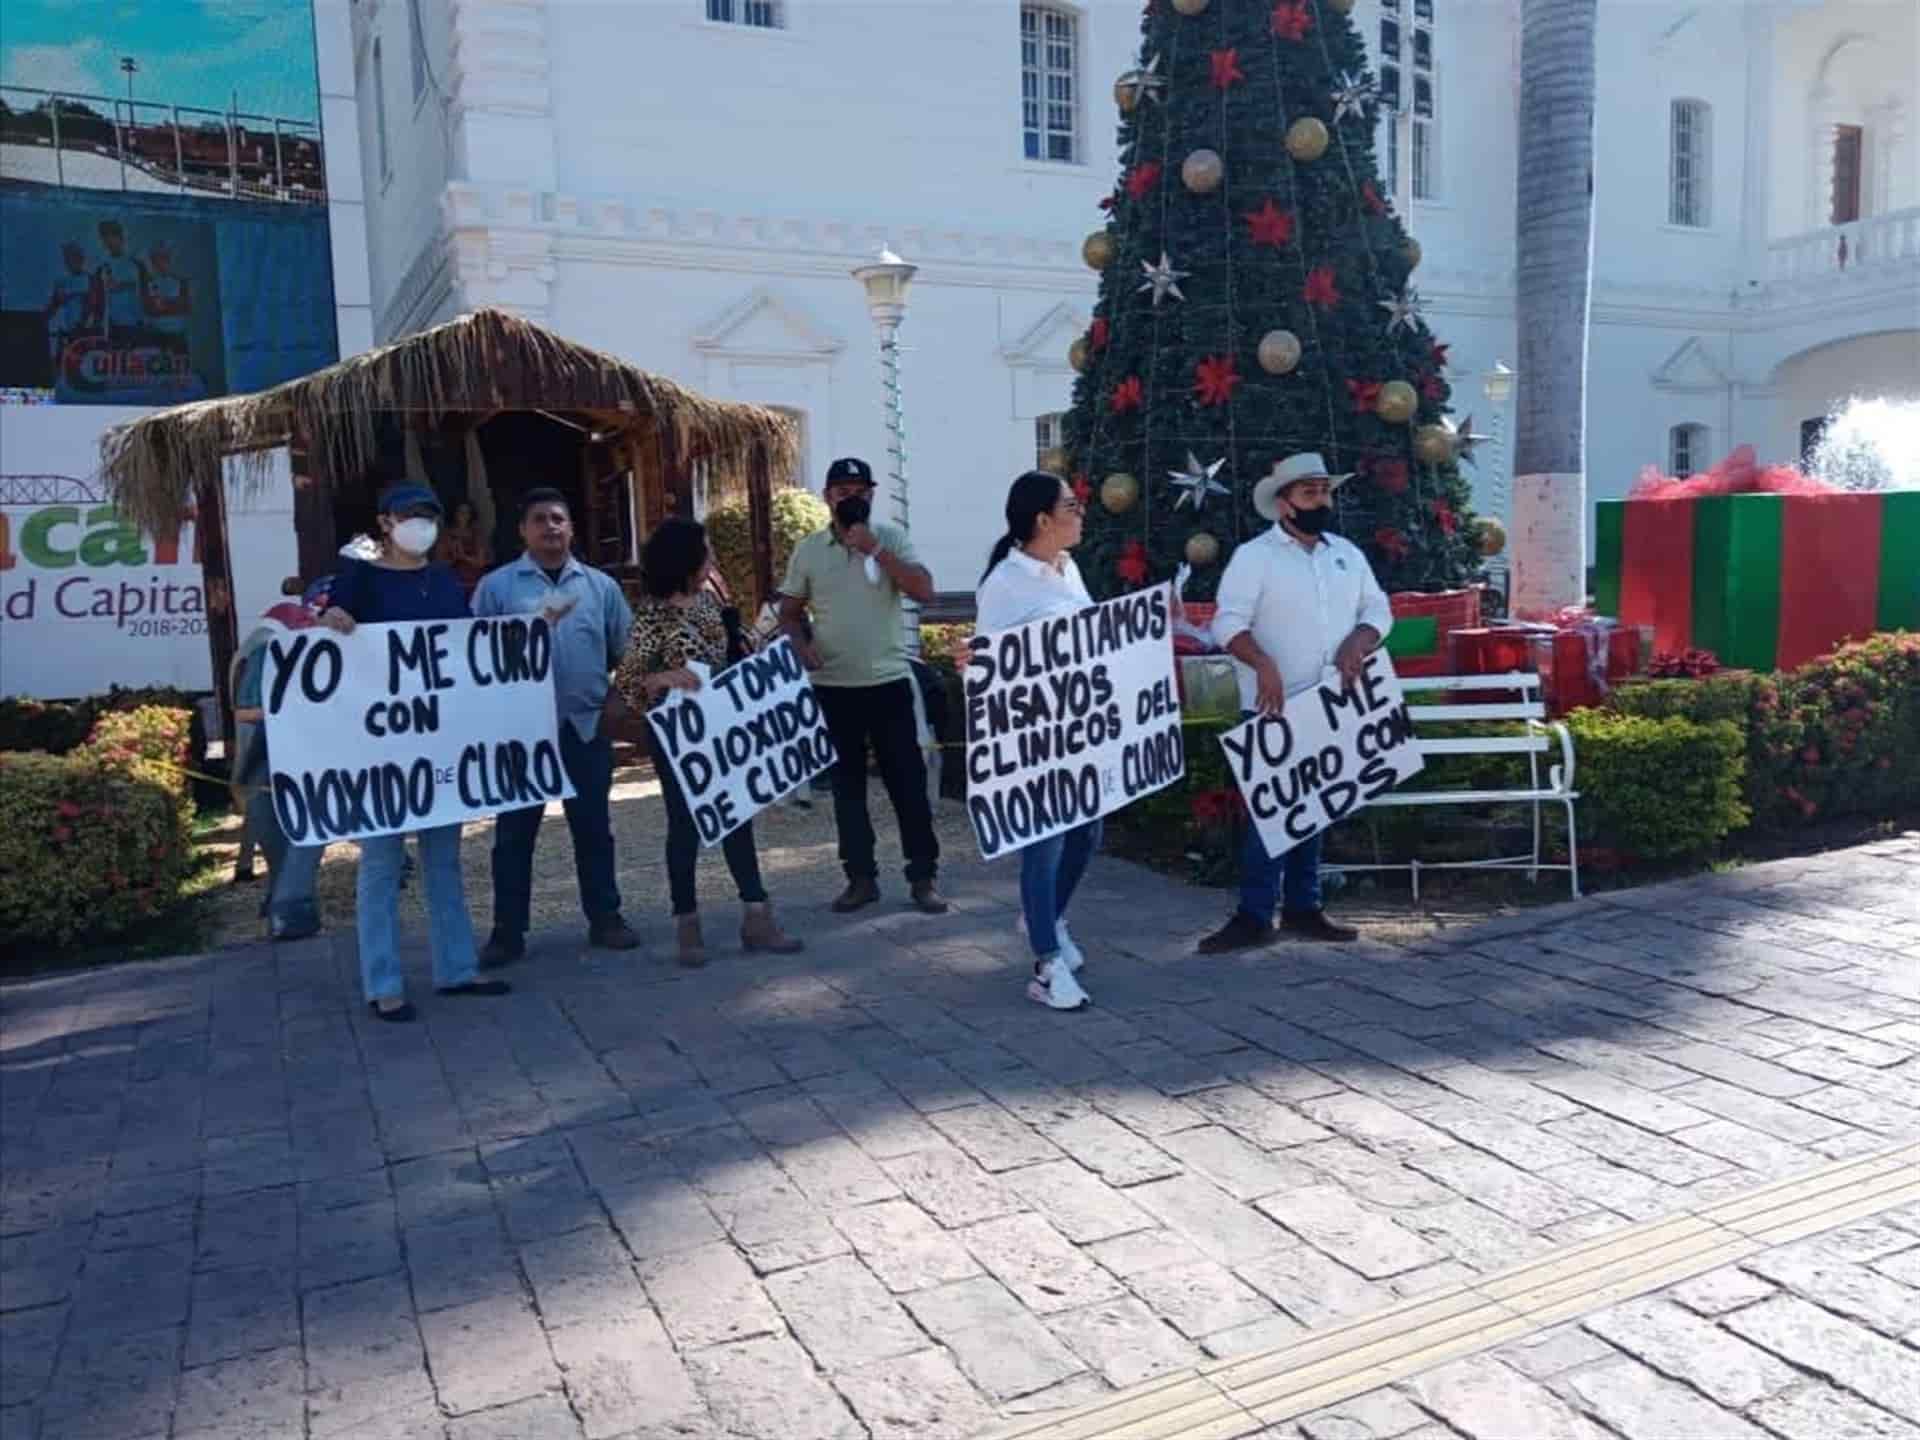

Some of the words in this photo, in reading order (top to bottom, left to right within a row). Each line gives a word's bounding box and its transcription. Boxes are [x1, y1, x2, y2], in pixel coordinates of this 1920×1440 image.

[54, 576, 204, 629] Capita
[967, 590, 1167, 697] SOLICITAMOS
[269, 635, 342, 715] YO
[388, 624, 454, 695] ME
[467, 617, 550, 686] CURO
[364, 694, 439, 737] CON
[652, 697, 705, 758] YO
[712, 639, 802, 712] TOMO
[968, 664, 1113, 743] ENSAYOS
[1223, 716, 1293, 782] YO
[1318, 656, 1389, 731] ME
[680, 687, 818, 796] DIOXIDO
[968, 703, 1121, 784] CLINICOS
[1136, 676, 1177, 725] DEL
[1251, 745, 1343, 819] CURO
[1356, 704, 1413, 761] CON
[272, 757, 434, 842] DIOXIDO
[436, 767, 455, 785] DE
[458, 739, 563, 808] CLORO
[694, 789, 738, 842] DE
[747, 726, 833, 804] CLORO
[969, 763, 1100, 854] DIOXIDO
[1122, 724, 1182, 797] CLORO
[1285, 757, 1397, 839] CDS
